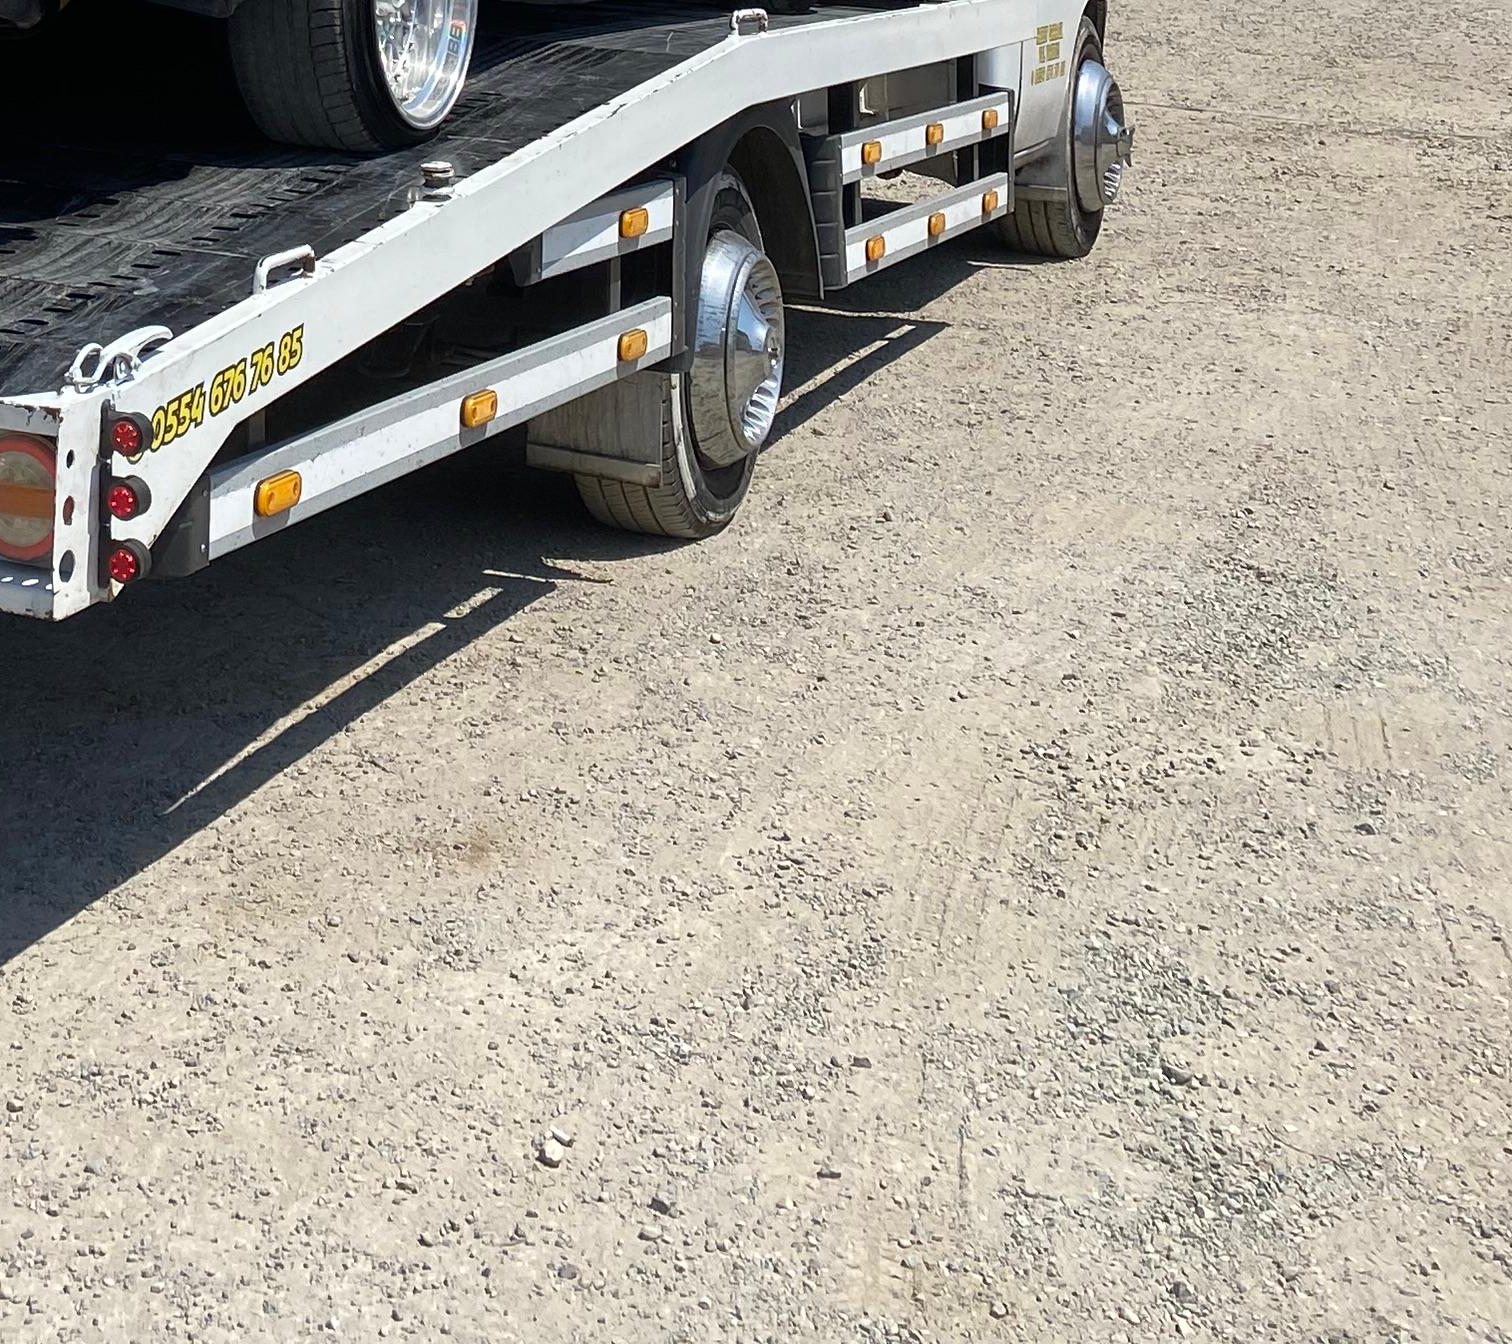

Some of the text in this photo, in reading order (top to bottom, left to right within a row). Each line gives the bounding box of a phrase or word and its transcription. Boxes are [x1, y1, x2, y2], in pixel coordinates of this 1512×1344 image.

[150, 322, 304, 452] 0554 676 76 85
